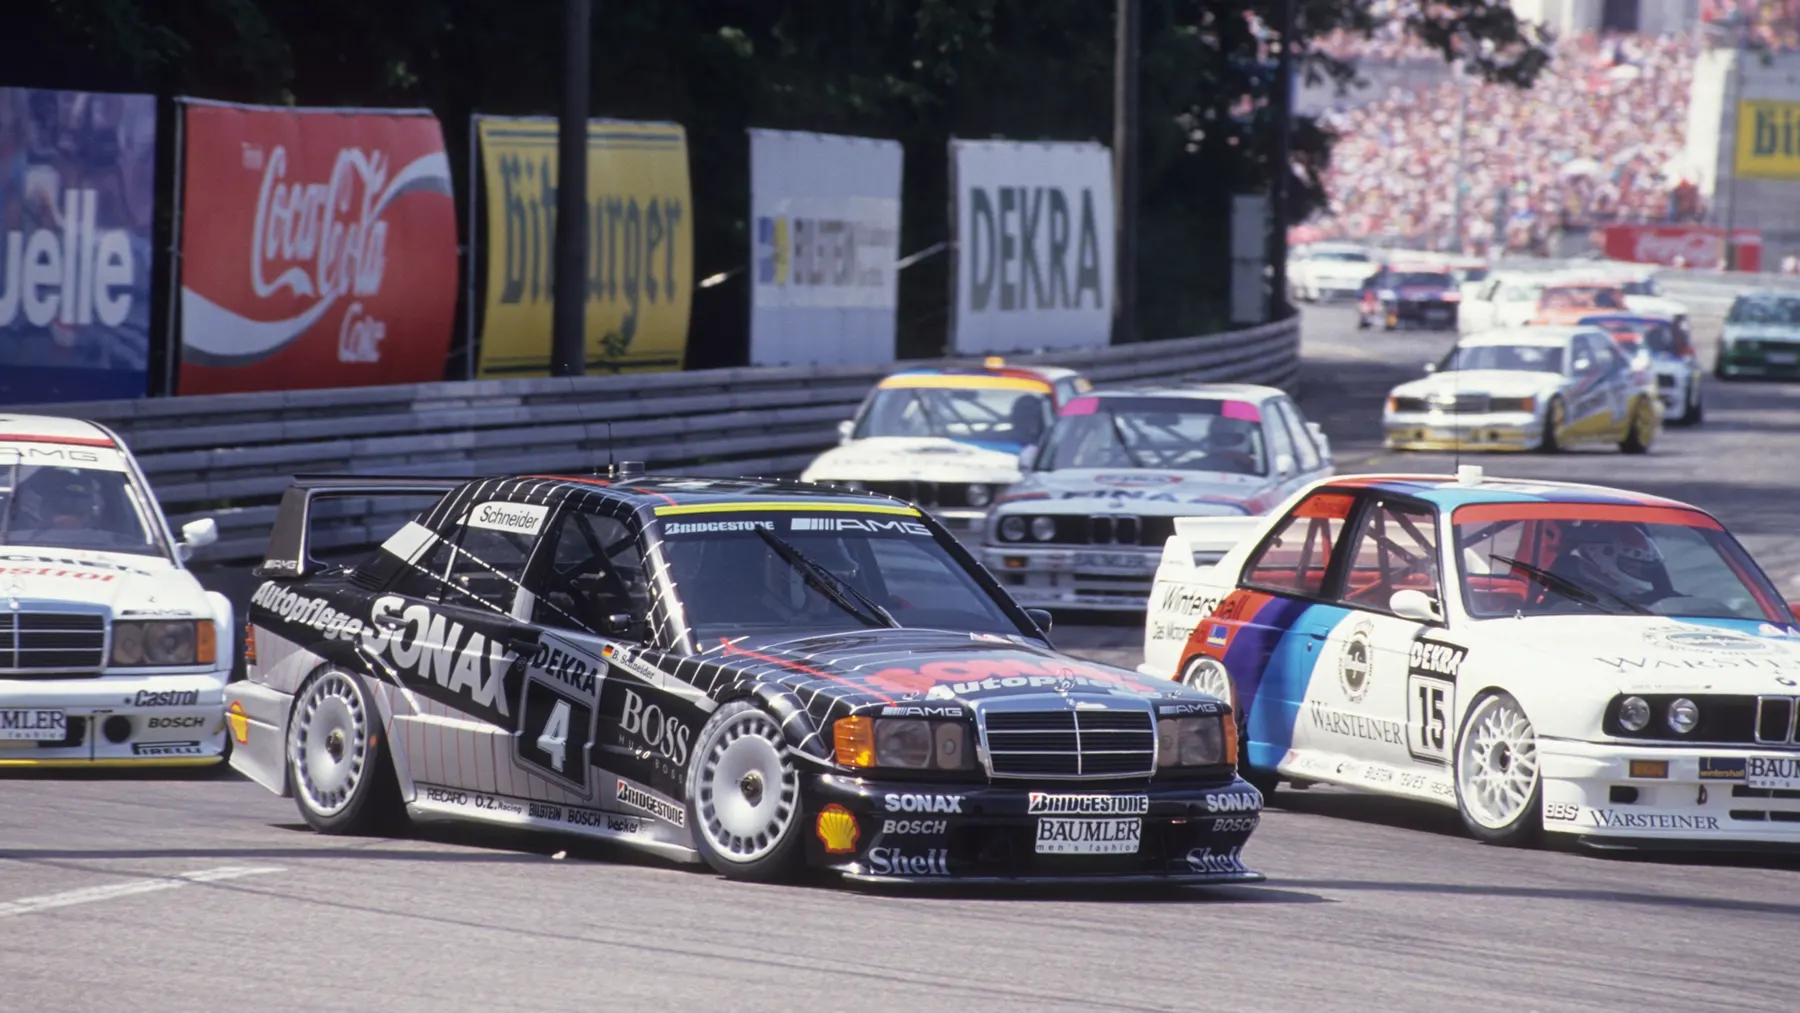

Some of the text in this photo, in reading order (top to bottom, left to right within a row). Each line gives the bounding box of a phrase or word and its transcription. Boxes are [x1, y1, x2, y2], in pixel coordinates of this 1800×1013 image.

[1754, 108, 1800, 156] bi
[500, 153, 682, 347] biturger
[970, 187, 1103, 313] DEKRA
[480, 505, 540, 529] Schneider
[836, 518, 933, 536] AMG
[250, 579, 363, 640] Autopflege
[361, 595, 520, 718] SONAX
[611, 649, 621, 661] B.
[1410, 641, 1463, 676] DEKRA
[531, 642, 598, 697] DEKRA
[134, 689, 199, 707] Castrol
[1176, 704, 1218, 714] AMG
[147, 717, 205, 728] BOSCH
[906, 706, 963, 717] AMG
[1310, 700, 1404, 745] WARSTEINER
[1419, 684, 1447, 752] 15
[537, 699, 571, 772] 4
[618, 688, 690, 767] BOSS
[132, 740, 202, 755] PIRELLI
[427, 787, 468, 806] RECARO
[528, 803, 563, 821] BILSTEIN
[567, 808, 601, 828] BOSCH
[607, 815, 639, 834] becker
[617, 780, 685, 827] BRIDGESTONE
[884, 793, 963, 813] SONAX
[1029, 795, 1148, 812] BRIDGESTONE
[1206, 792, 1261, 812] SONAX
[1545, 801, 1579, 822] BBS
[882, 819, 948, 834] BOSCH
[1212, 818, 1258, 832] BOSCH
[1590, 809, 1720, 830] WARSTEINER
[1036, 843, 1140, 853] men's fashion
[1186, 846, 1246, 873] Shell
[868, 846, 951, 875] Shell
